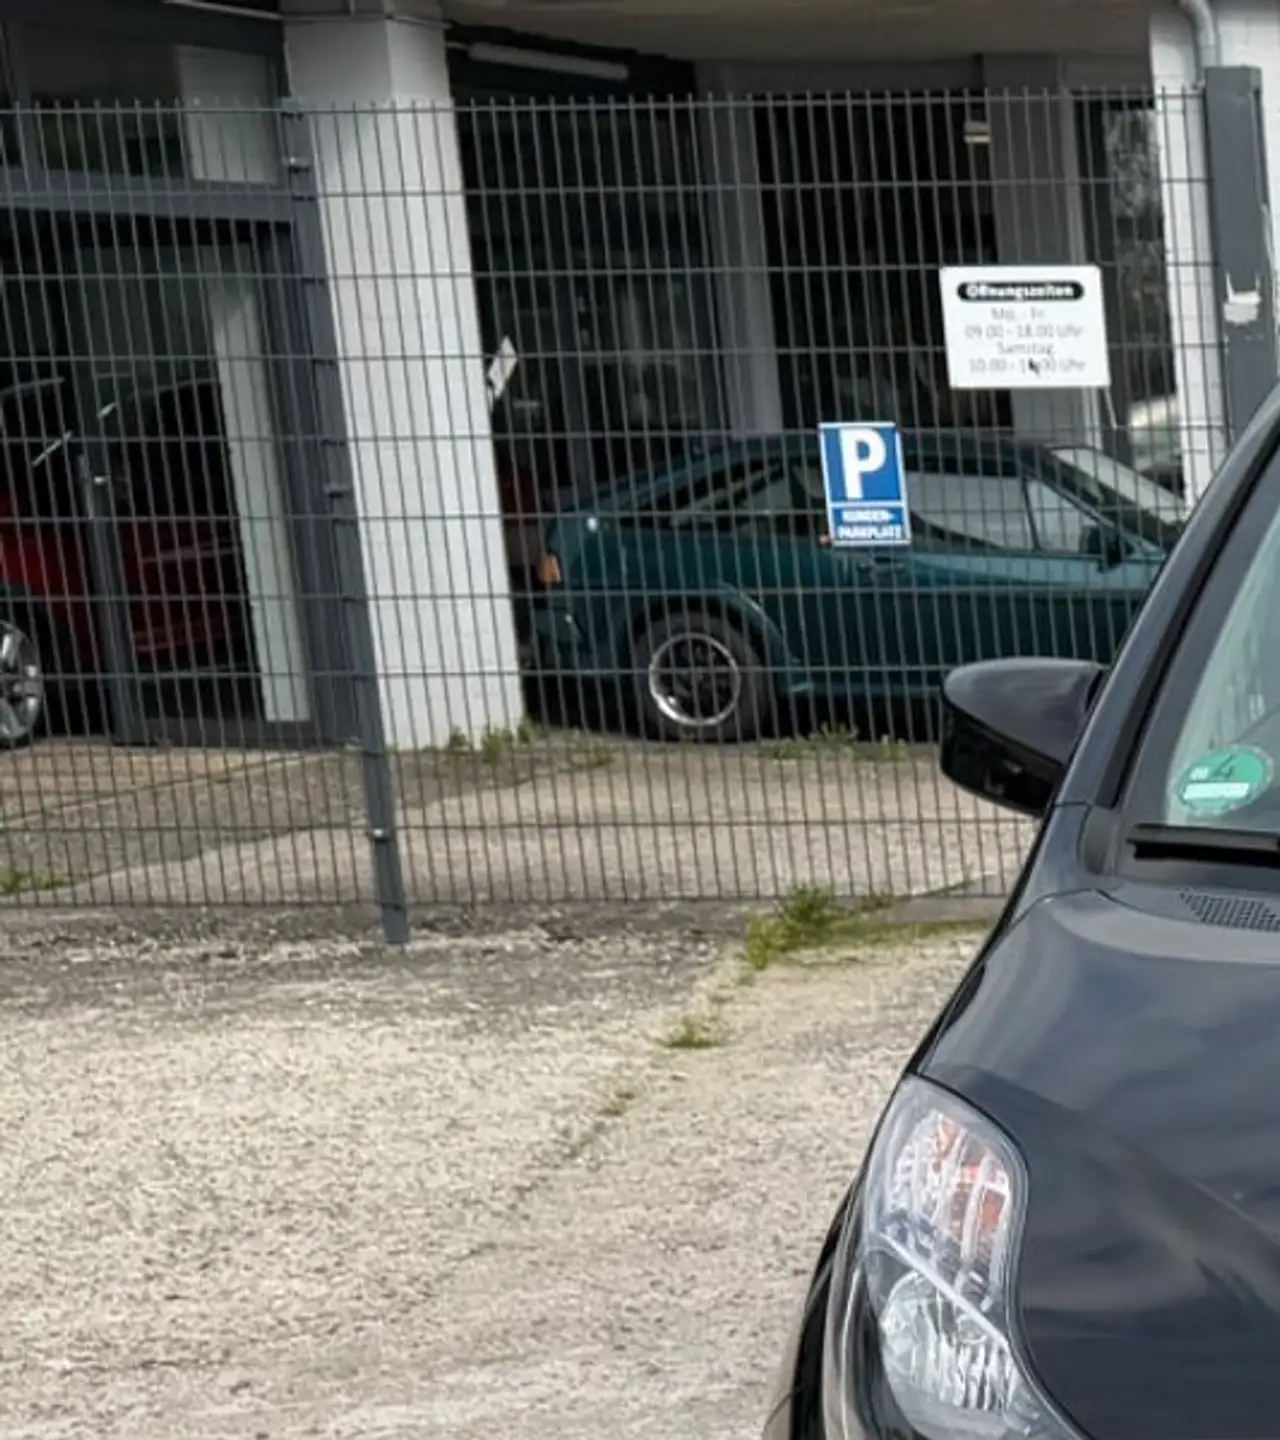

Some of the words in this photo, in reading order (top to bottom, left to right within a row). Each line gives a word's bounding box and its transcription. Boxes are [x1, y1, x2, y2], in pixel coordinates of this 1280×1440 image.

[965, 281, 1074, 300] Öffnungszeiten
[1057, 323, 1083, 337] Uhr
[997, 342, 1054, 356] Samstag
[840, 428, 886, 498] P
